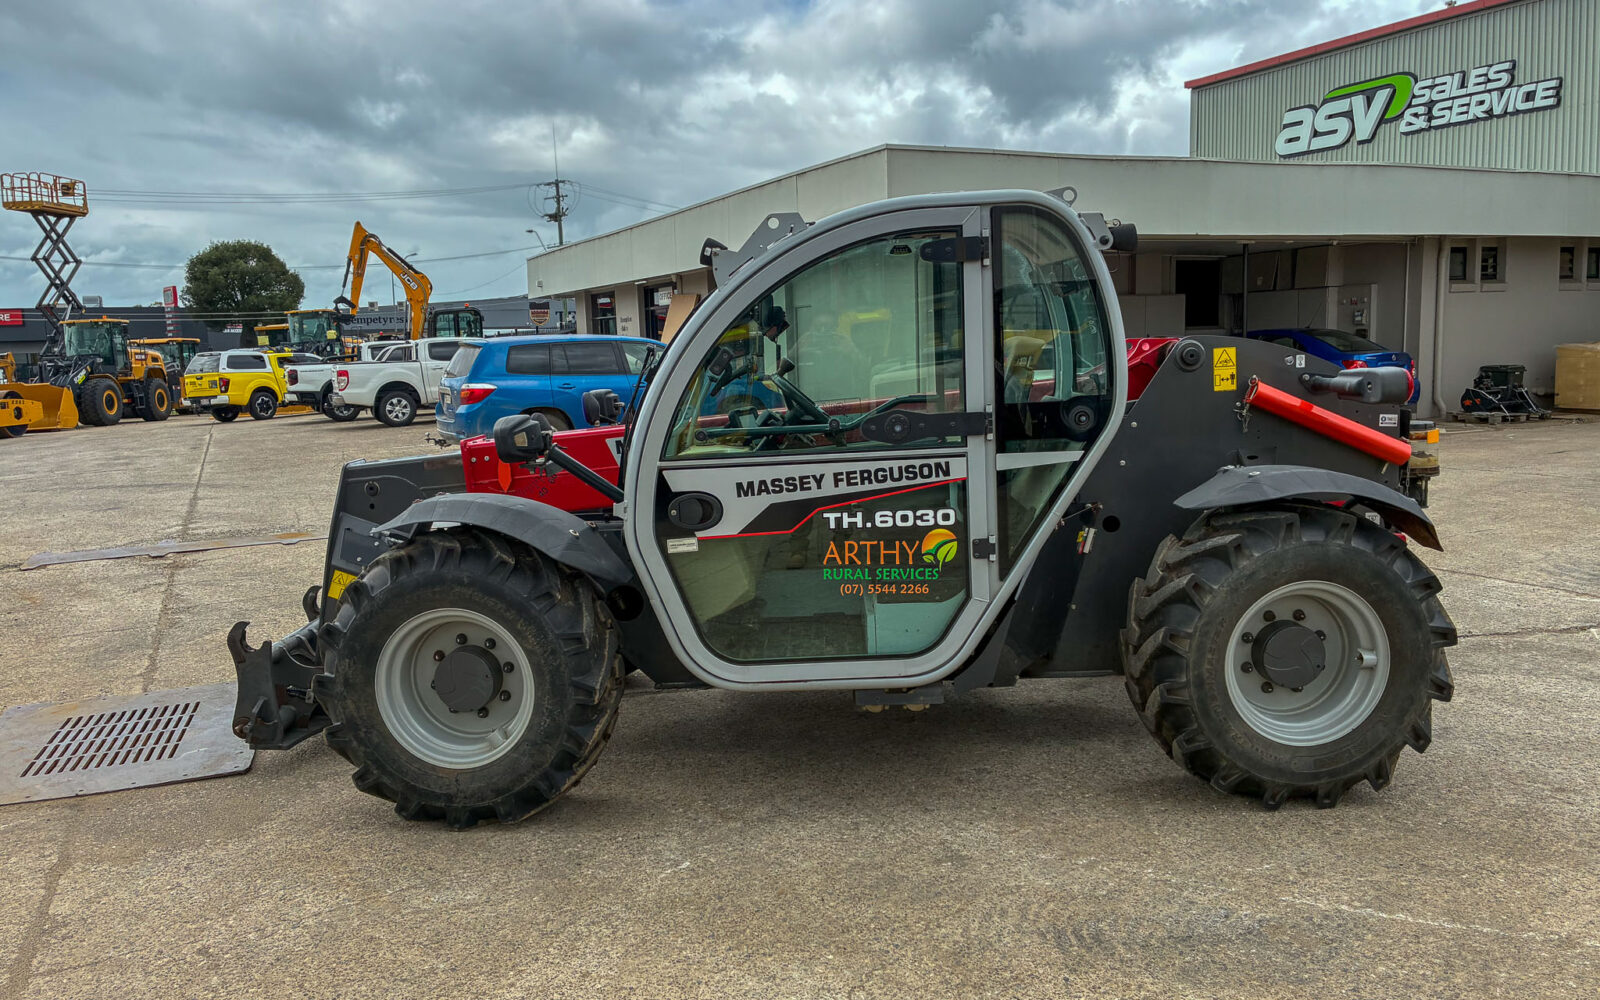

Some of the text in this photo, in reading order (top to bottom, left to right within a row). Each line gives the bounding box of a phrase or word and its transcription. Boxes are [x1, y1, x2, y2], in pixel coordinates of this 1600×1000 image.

[1400, 77, 1563, 136] & SERVICE
[400, 271, 418, 290] JCB
[345, 315, 404, 326] empetyres
[736, 461, 951, 498] MASSEY FERGUSON
[822, 509, 957, 529] TH.6030
[823, 541, 919, 565] ARTHY
[823, 568, 939, 581] RURAL SERVICES
[840, 583, 930, 596] (07) 5544 2266
